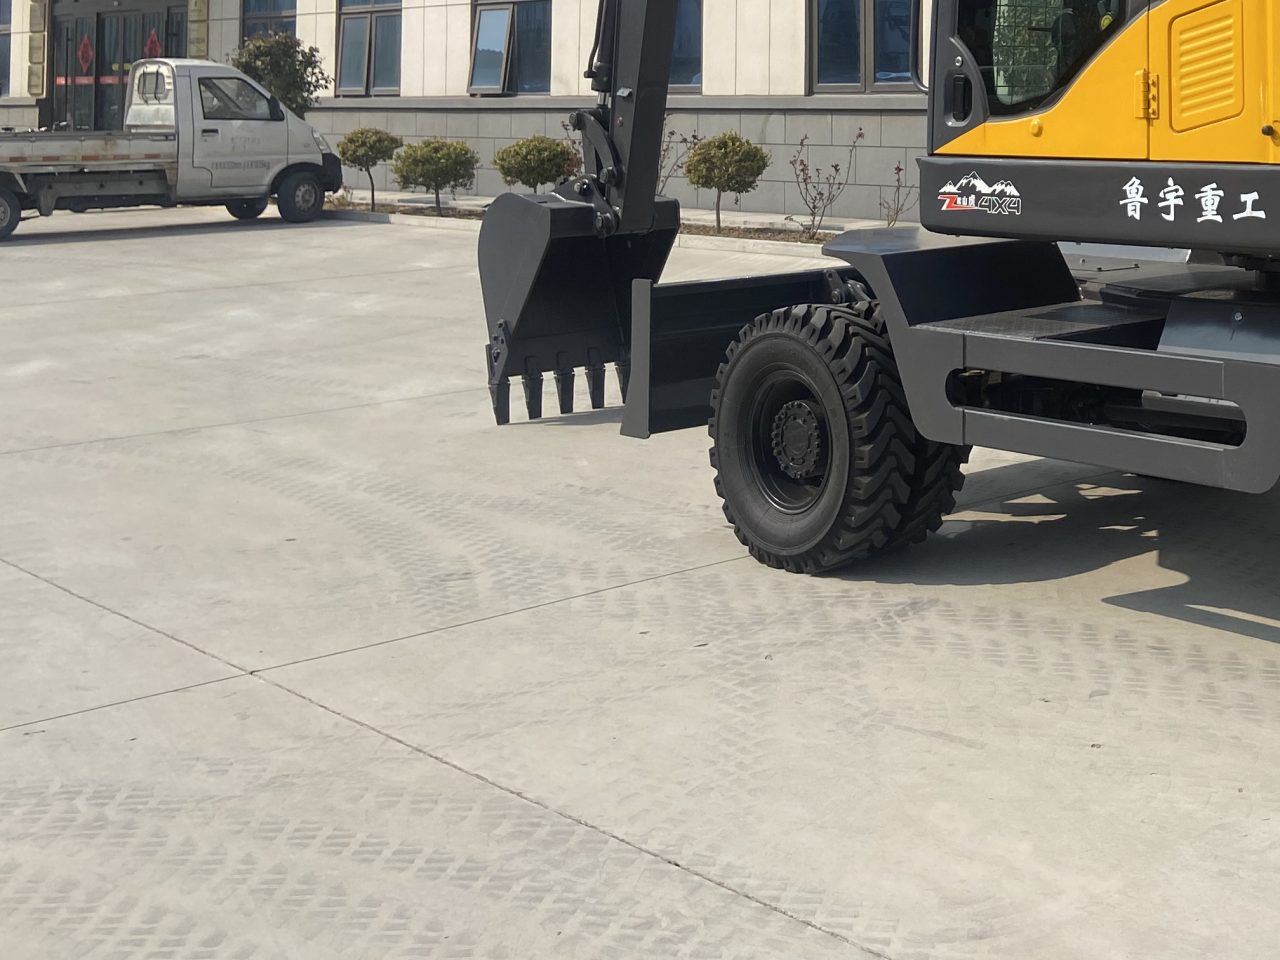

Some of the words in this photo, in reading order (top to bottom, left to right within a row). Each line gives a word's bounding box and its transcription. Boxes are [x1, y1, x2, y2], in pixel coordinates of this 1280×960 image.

[978, 196, 1022, 215] 4X4
[1119, 176, 1266, 223] 鲁宇重工
